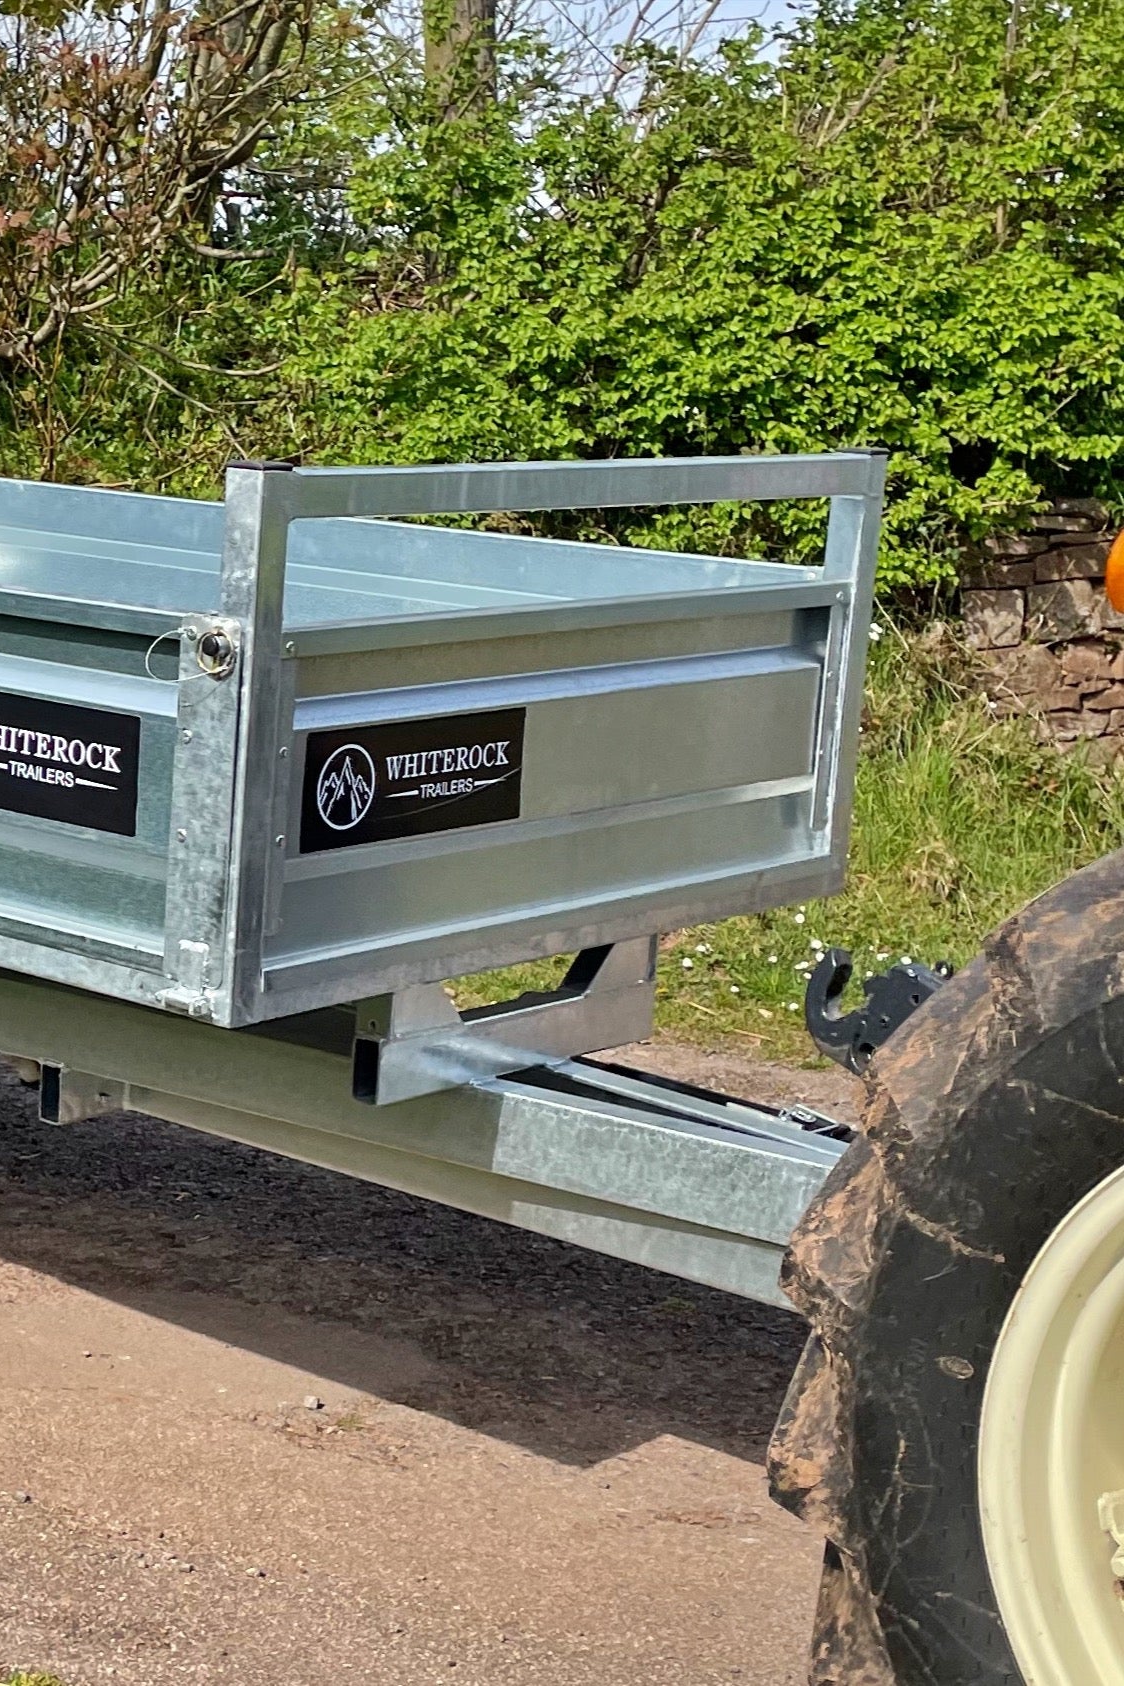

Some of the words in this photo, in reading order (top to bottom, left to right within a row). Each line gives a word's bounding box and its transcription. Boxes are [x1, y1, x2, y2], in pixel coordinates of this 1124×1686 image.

[386, 741, 510, 780] WHITEROCK
[8, 761, 75, 788] TRAILERS
[420, 778, 473, 799] TRAILERS
